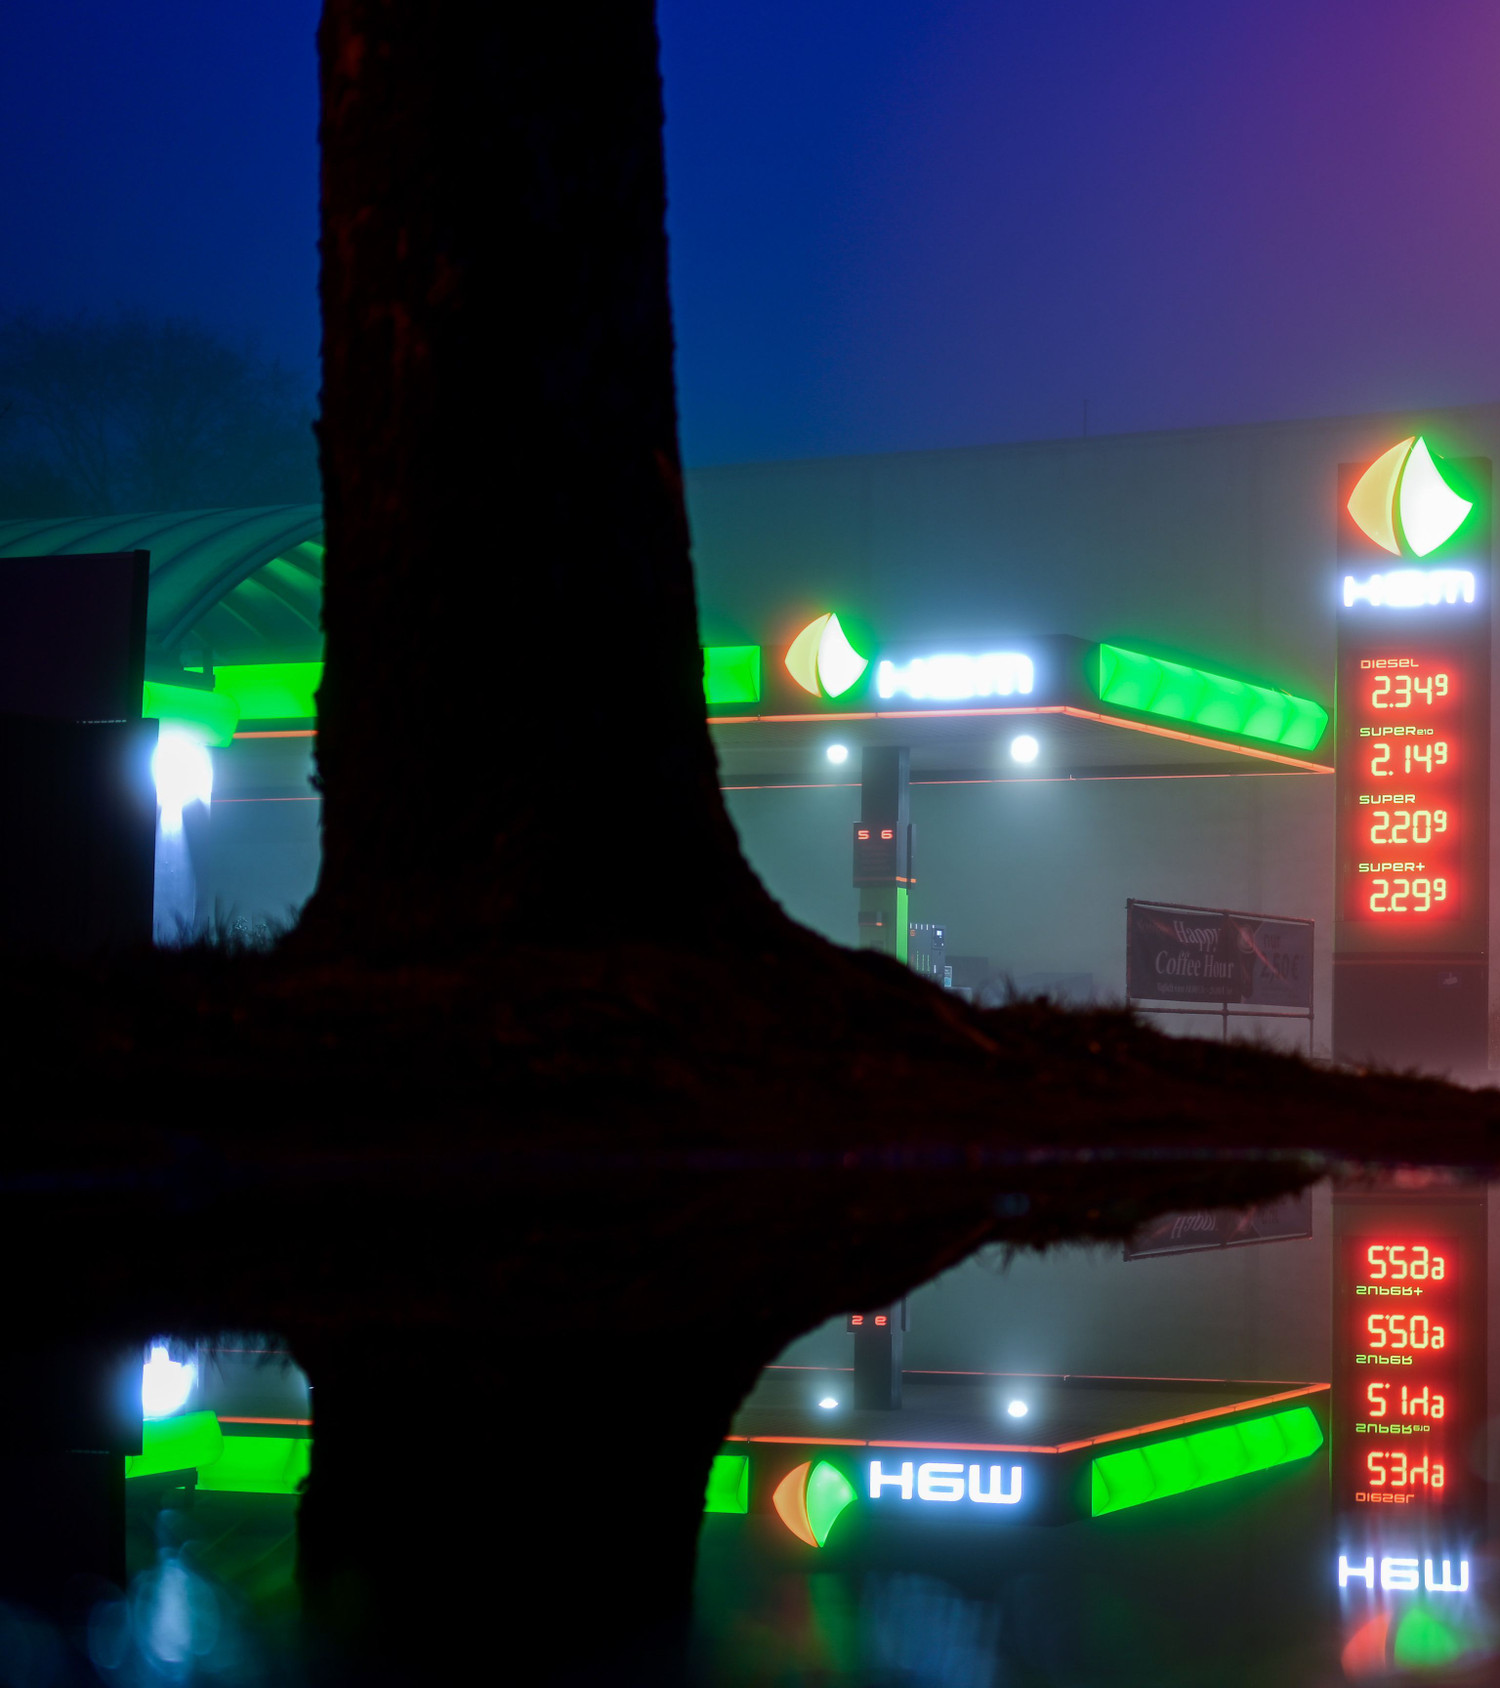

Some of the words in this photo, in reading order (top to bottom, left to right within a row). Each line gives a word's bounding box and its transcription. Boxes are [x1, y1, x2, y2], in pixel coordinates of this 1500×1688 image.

[1360, 658, 1419, 669] DIESEL
[879, 653, 1033, 699] HM
[1359, 794, 1416, 804] SUPER
[1358, 862, 1425, 873] SUPER+
[1173, 920, 1220, 953] Happy
[1155, 951, 1201, 977] Coffee
[1203, 954, 1235, 979] Hour
